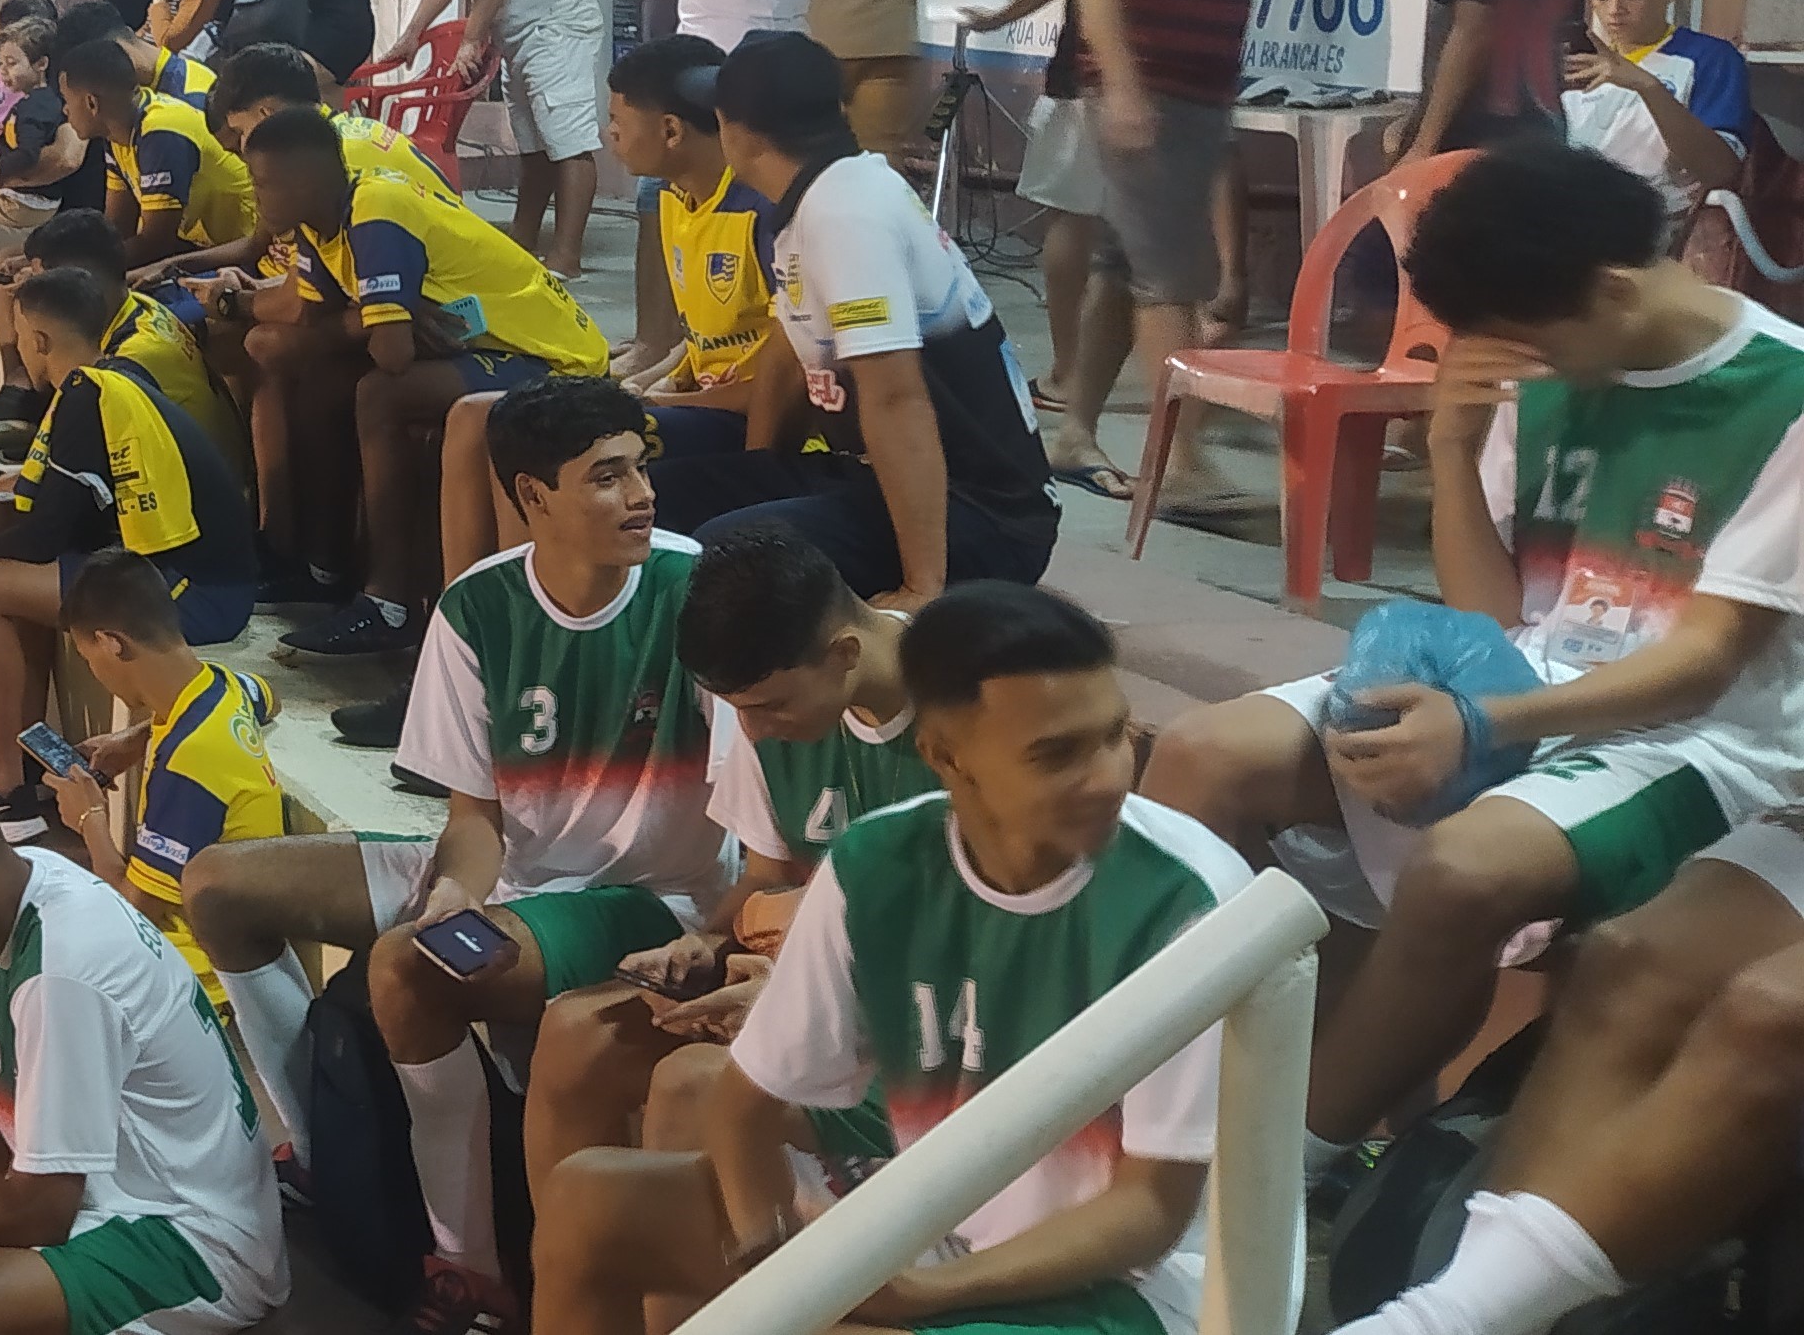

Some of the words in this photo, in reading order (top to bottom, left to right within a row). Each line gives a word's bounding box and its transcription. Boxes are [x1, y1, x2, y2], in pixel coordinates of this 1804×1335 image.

[1007, 21, 1035, 47] RUA
[138, 490, 158, 513] ES
[518, 685, 559, 756] 3
[911, 977, 986, 1072] 14
